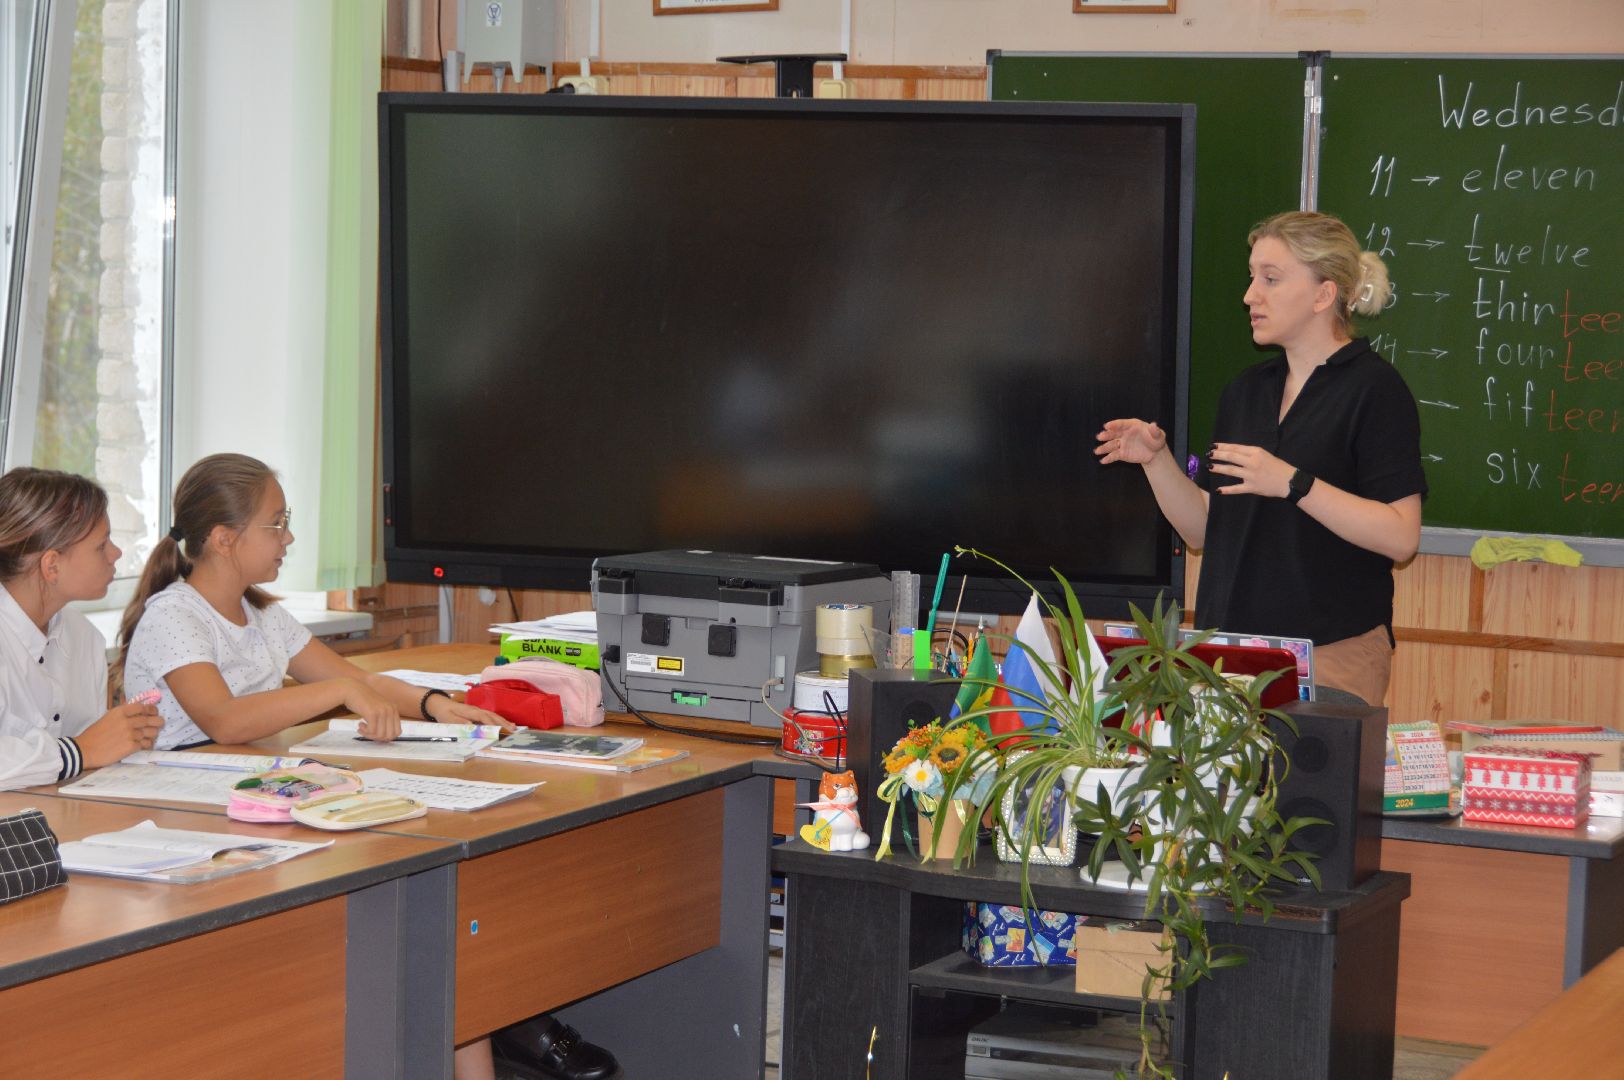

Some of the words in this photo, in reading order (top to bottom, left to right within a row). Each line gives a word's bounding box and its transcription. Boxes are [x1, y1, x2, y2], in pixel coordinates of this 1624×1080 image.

[1438, 74, 1624, 129] Wednesd
[1370, 155, 1396, 198] 11
[1462, 144, 1595, 193] eleven
[1366, 222, 1395, 257] 12
[1464, 213, 1590, 267] twelve
[1473, 277, 1624, 338] thirtee
[1370, 333, 1397, 365] 14
[1476, 327, 1624, 382] fourtee
[522, 643, 562, 655] BLANK
